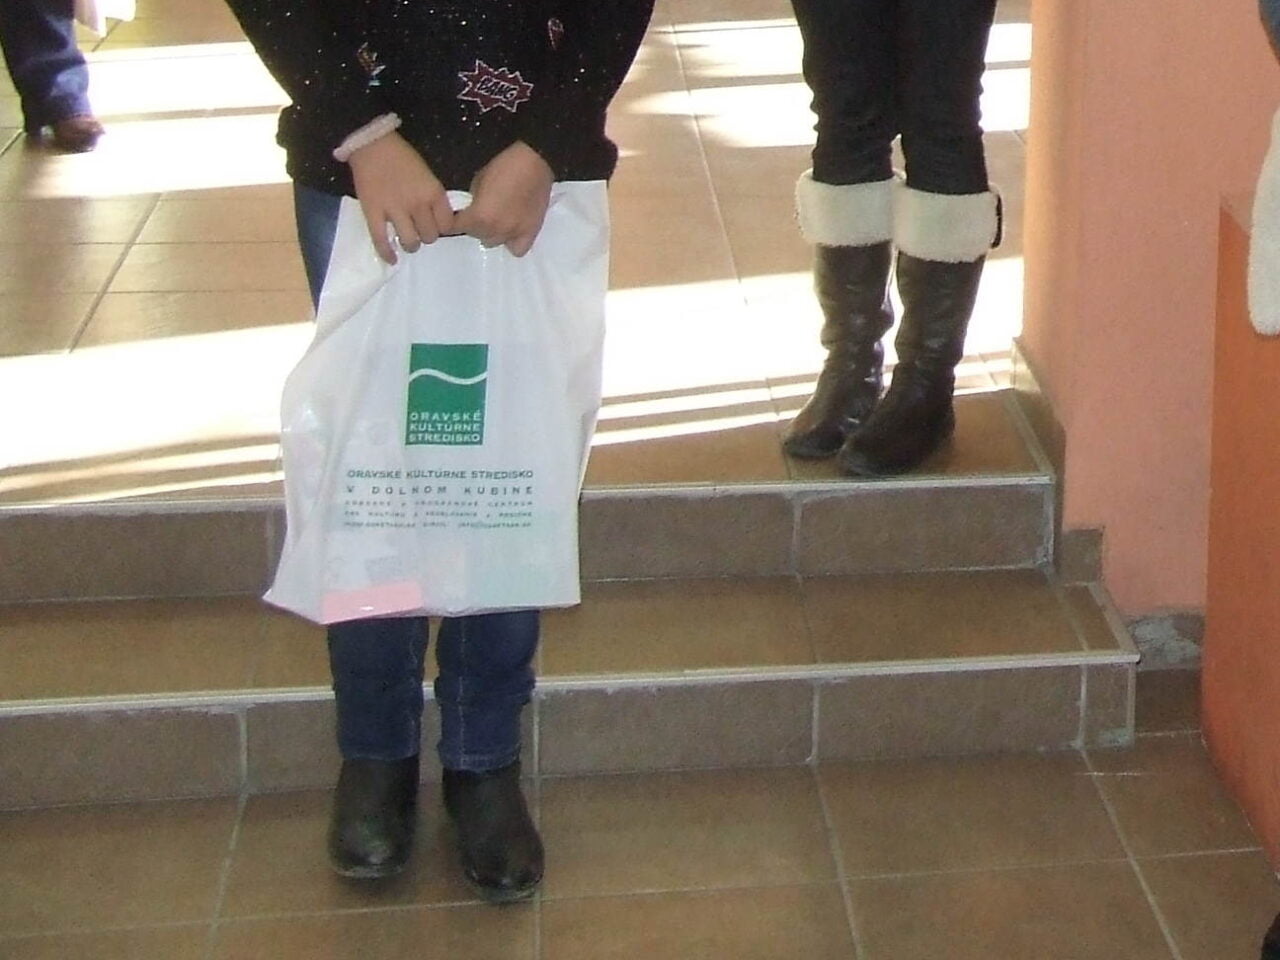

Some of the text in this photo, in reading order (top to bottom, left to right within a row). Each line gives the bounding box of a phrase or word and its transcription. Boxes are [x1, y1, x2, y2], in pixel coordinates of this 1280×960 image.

[409, 409, 482, 422] ORAVSKÉ
[408, 432, 481, 442] STREDISKO
[471, 470, 534, 480] STREDISKO
